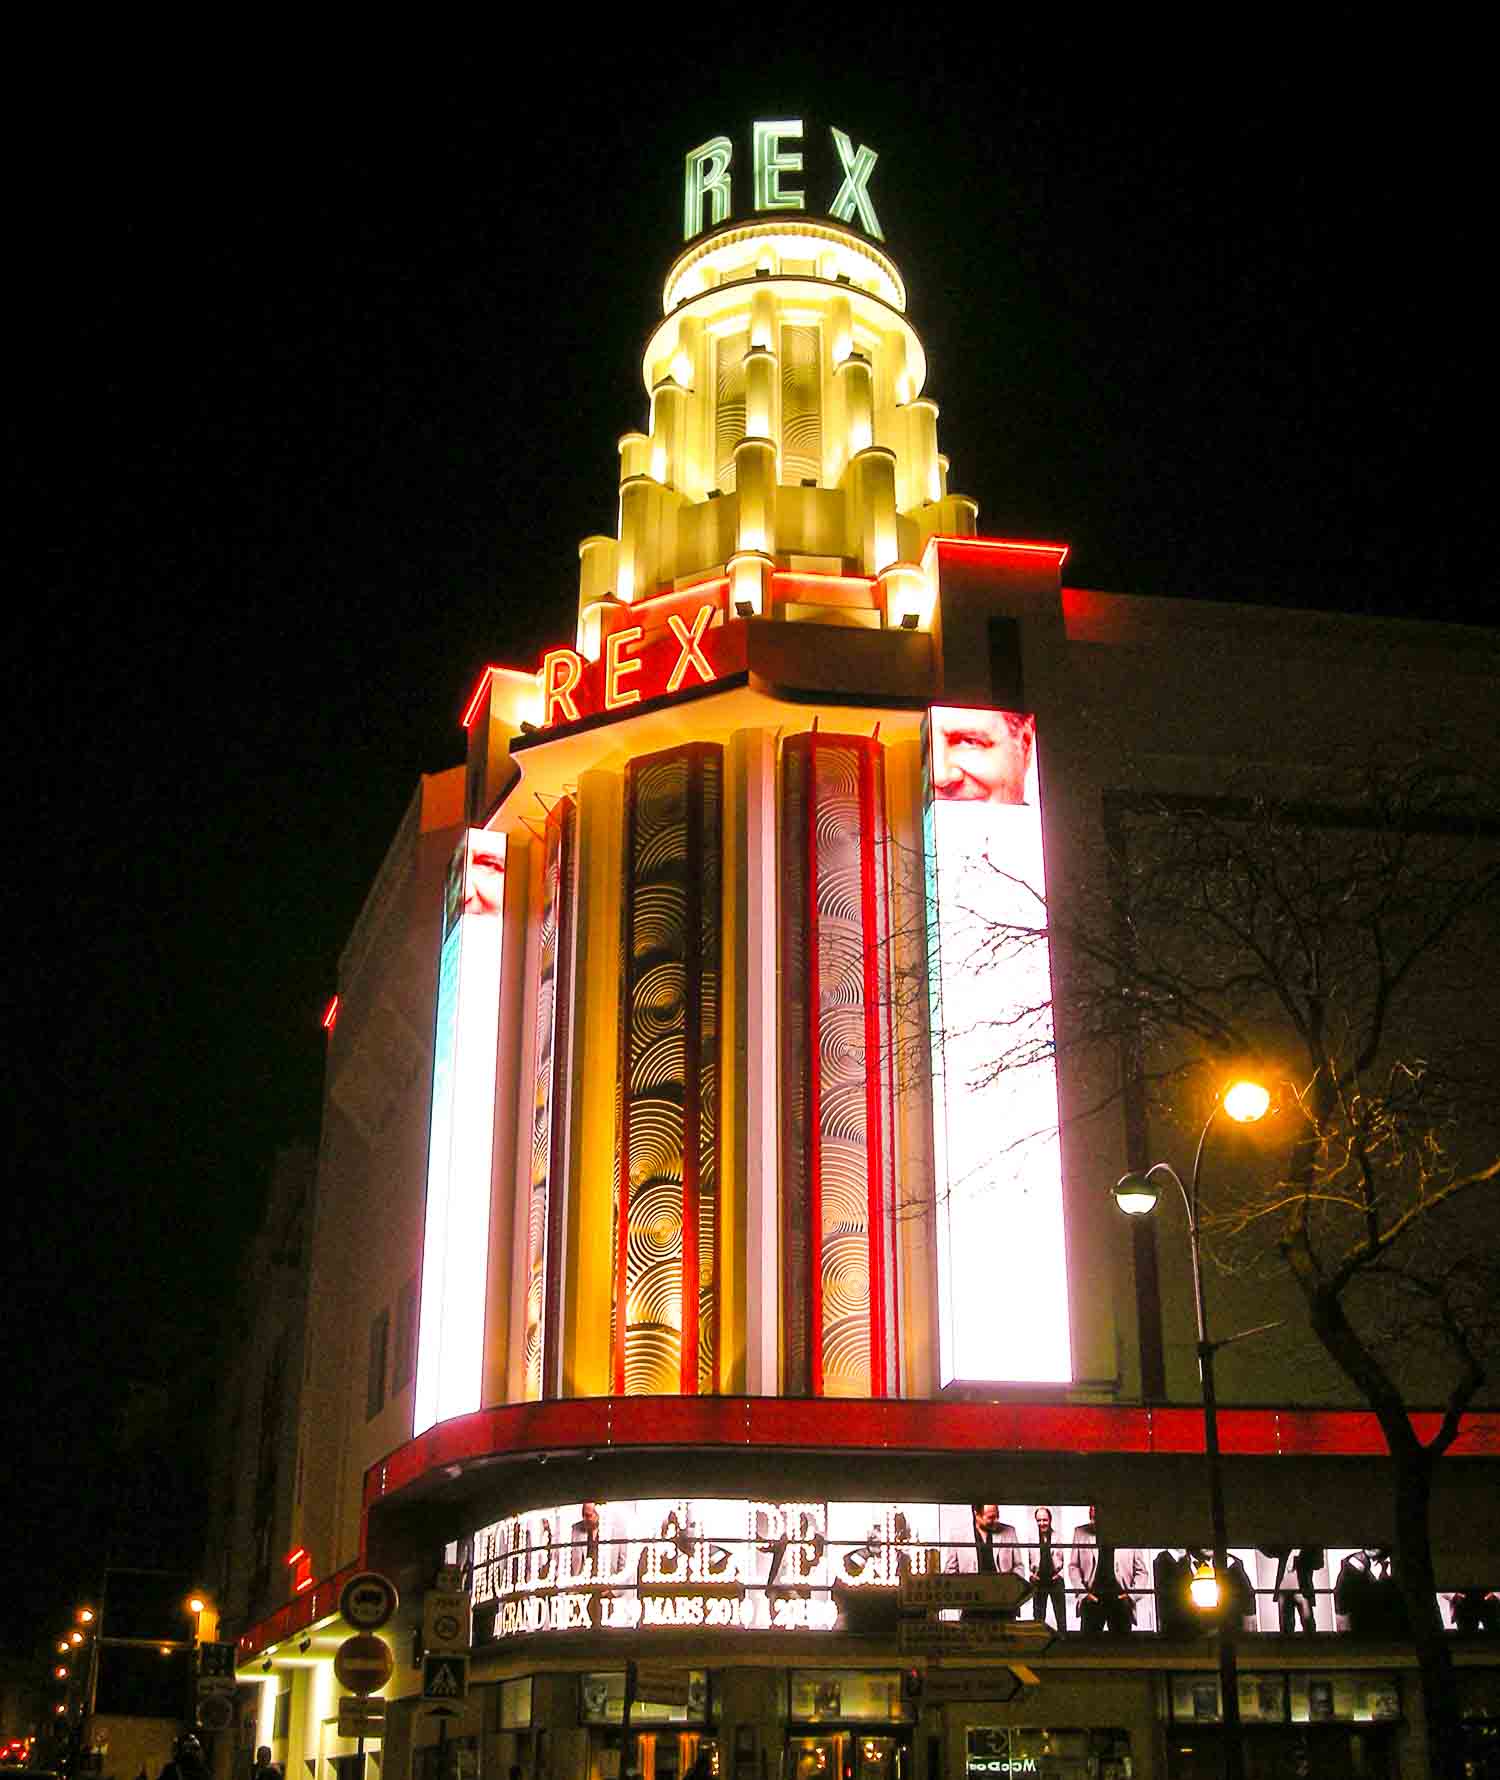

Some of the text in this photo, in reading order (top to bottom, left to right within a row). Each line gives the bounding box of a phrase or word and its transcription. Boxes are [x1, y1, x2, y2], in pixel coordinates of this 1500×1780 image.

[684, 119, 886, 242] REX
[541, 605, 716, 728] REX
[503, 1598, 545, 1634] GRAND
[643, 1597, 704, 1625] MARS
